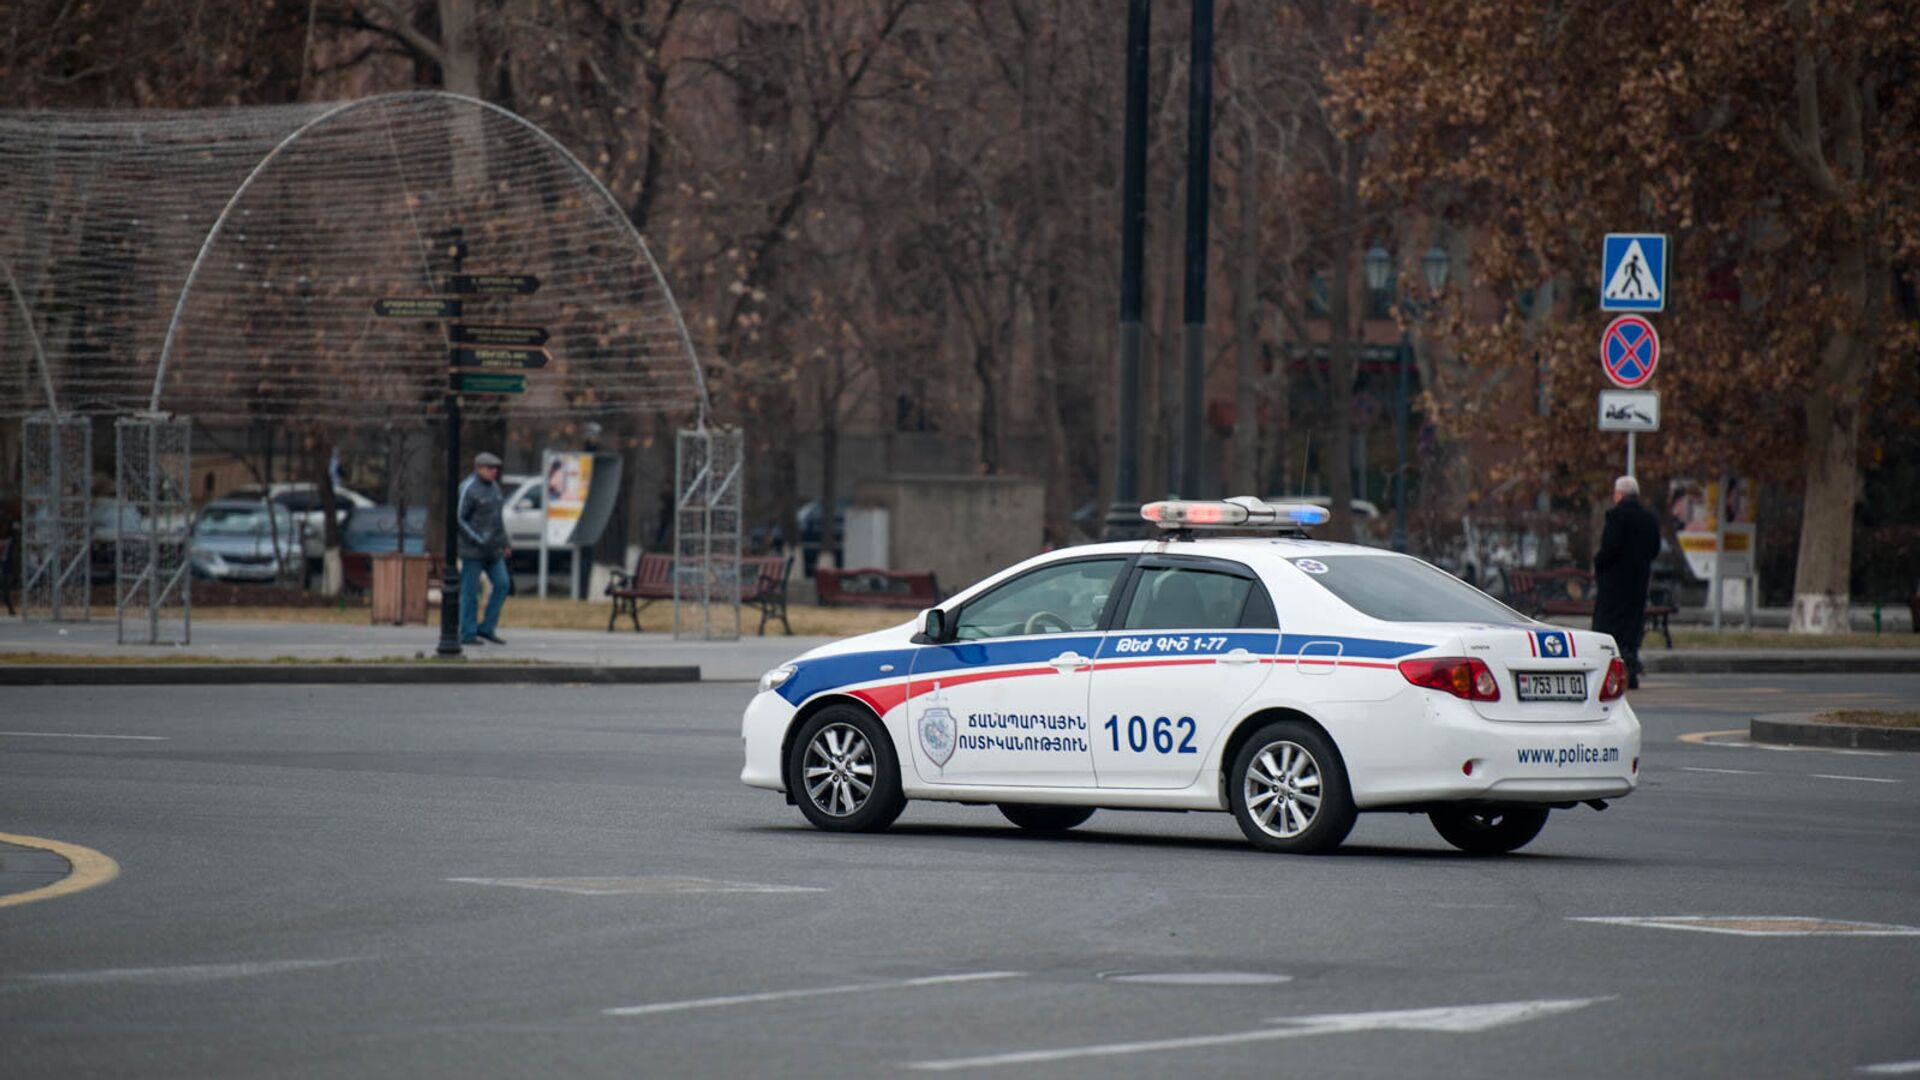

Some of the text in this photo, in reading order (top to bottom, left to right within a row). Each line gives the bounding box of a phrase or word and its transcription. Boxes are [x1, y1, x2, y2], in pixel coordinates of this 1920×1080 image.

[1193, 637, 1228, 651] 1-77
[1532, 676, 1551, 694] 753
[1570, 676, 1583, 694] 01
[967, 712, 1087, 731] ՃԱՆԱՊԱՐՀԱՅԻՆ
[1104, 714, 1198, 754] 1062
[958, 735, 1088, 752] ՈՍՏԻԿԱՆՈՒԹՅՈՒՆ
[1517, 742, 1619, 768] www.police.am
